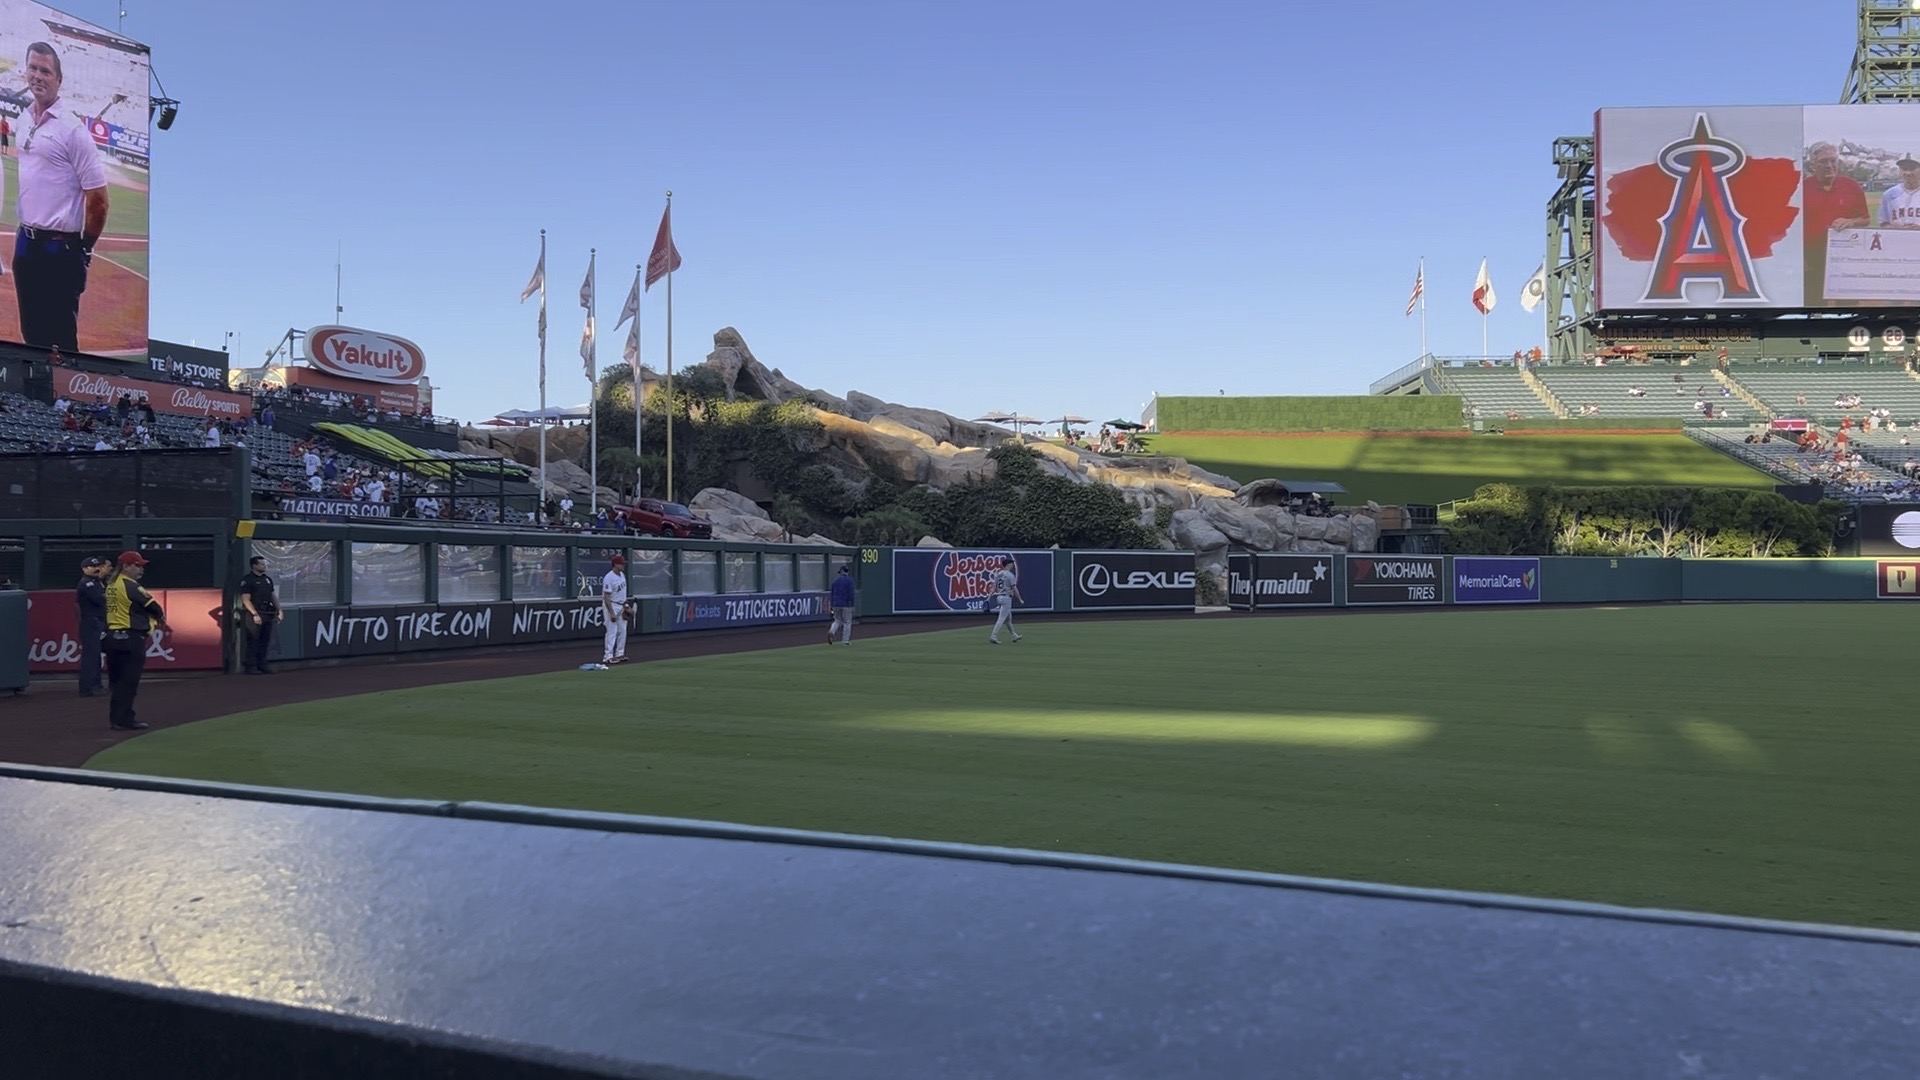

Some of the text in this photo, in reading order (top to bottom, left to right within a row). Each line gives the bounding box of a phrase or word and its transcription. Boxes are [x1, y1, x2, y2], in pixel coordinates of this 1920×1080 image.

[150, 355, 222, 380] TEAM STORE
[329, 338, 408, 373] Yakult
[69, 373, 115, 403] Bally
[171, 388, 240, 415] Bally SPORTS
[282, 499, 391, 518] 714TICKETS.COM
[862, 549, 878, 563] 390
[1113, 571, 1195, 588] LEXUS
[1374, 562, 1435, 579] YOKOHAMA
[1459, 575, 1521, 588] MemorialCare
[1407, 586, 1435, 600] TIRES
[513, 604, 565, 635] NITTO
[726, 597, 811, 621] 714TICKETS.COM
[315, 607, 491, 647] NITTO TIRE.COM
